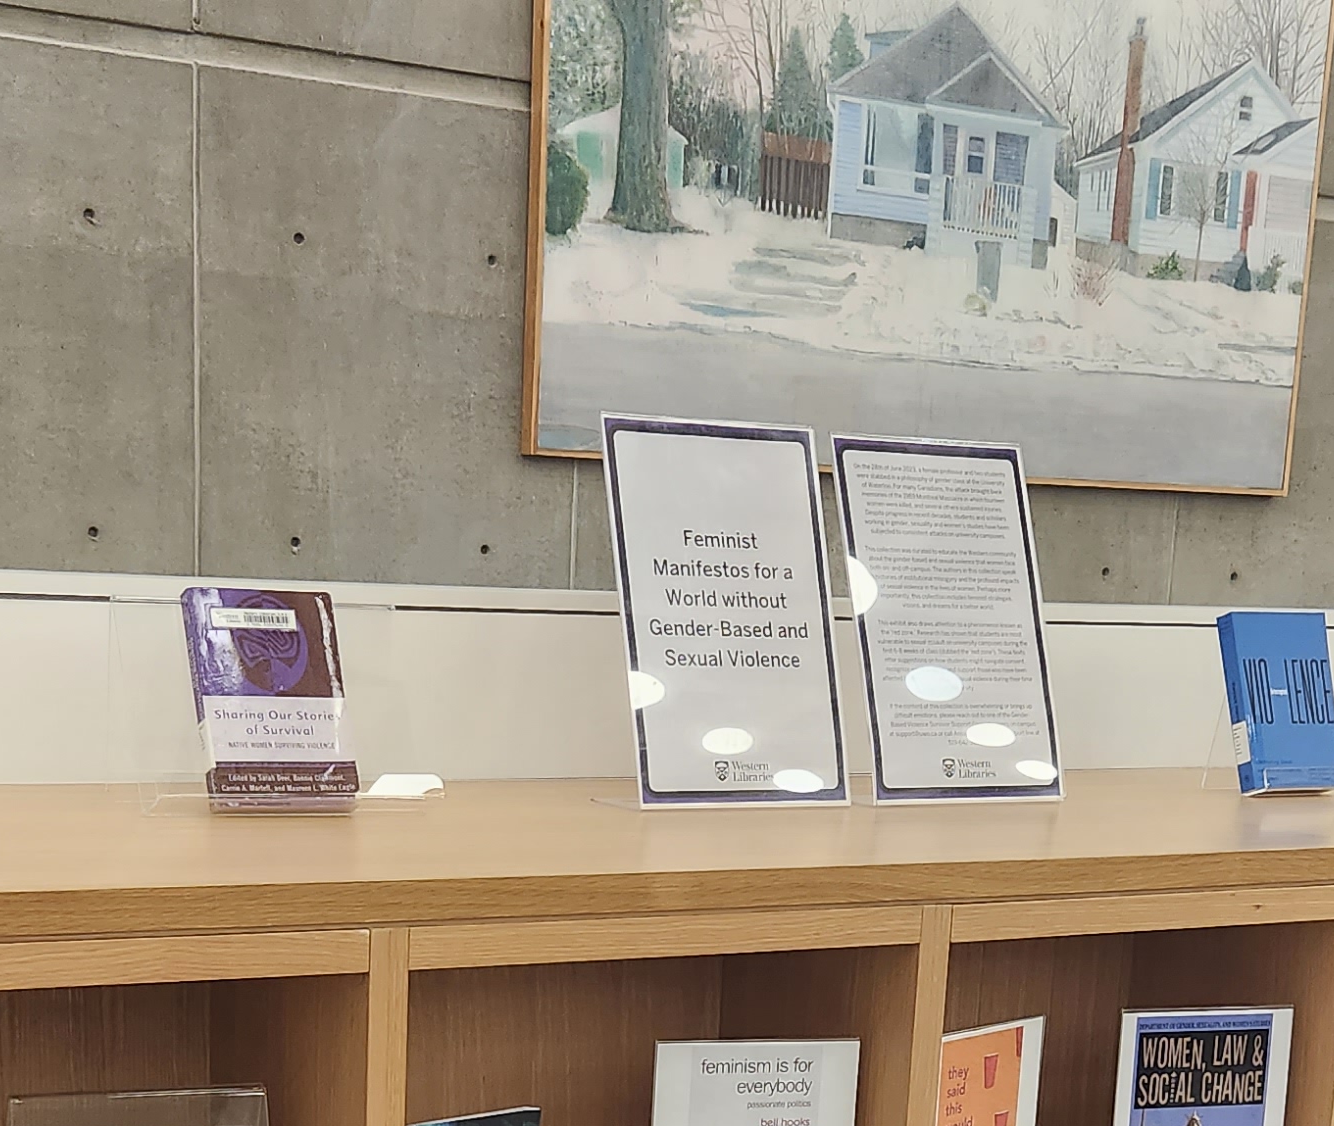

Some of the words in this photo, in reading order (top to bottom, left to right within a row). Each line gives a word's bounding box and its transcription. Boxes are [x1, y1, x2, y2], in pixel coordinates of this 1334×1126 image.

[683, 529, 758, 549] Feminist
[652, 558, 749, 580] Manifestos
[753, 561, 779, 580] for
[782, 566, 793, 580] a
[665, 588, 717, 607] World
[721, 590, 787, 609] without
[649, 619, 773, 639] Gender-Based
[777, 621, 809, 639] and
[665, 649, 723, 668] Sexual
[727, 650, 801, 668] Violence
[214, 709, 264, 723] Sharing
[268, 709, 293, 722] Our
[246, 724, 259, 735] of
[263, 725, 314, 736] Survival
[731, 760, 769, 771] Western
[957, 759, 992, 769] Western
[732, 771, 774, 782] Libraries
[958, 769, 997, 779] Libraries
[1143, 1036, 1206, 1072] WOMEN,
[1213, 1034, 1248, 1066] LAW
[1252, 1035, 1264, 1066] &
[701, 1058, 771, 1075] feminism
[775, 1059, 789, 1073] is
[793, 1057, 813, 1074] for
[947, 1066, 969, 1081] they
[736, 1078, 813, 1097] everybody
[947, 1083, 966, 1099] said
[1201, 1070, 1263, 1104] CHANGE
[747, 1101, 785, 1110] passionate
[787, 1100, 811, 1109] politics
[945, 1102, 962, 1116] this
[760, 1118, 779, 1126] bell
[781, 1117, 810, 1126] hooks
